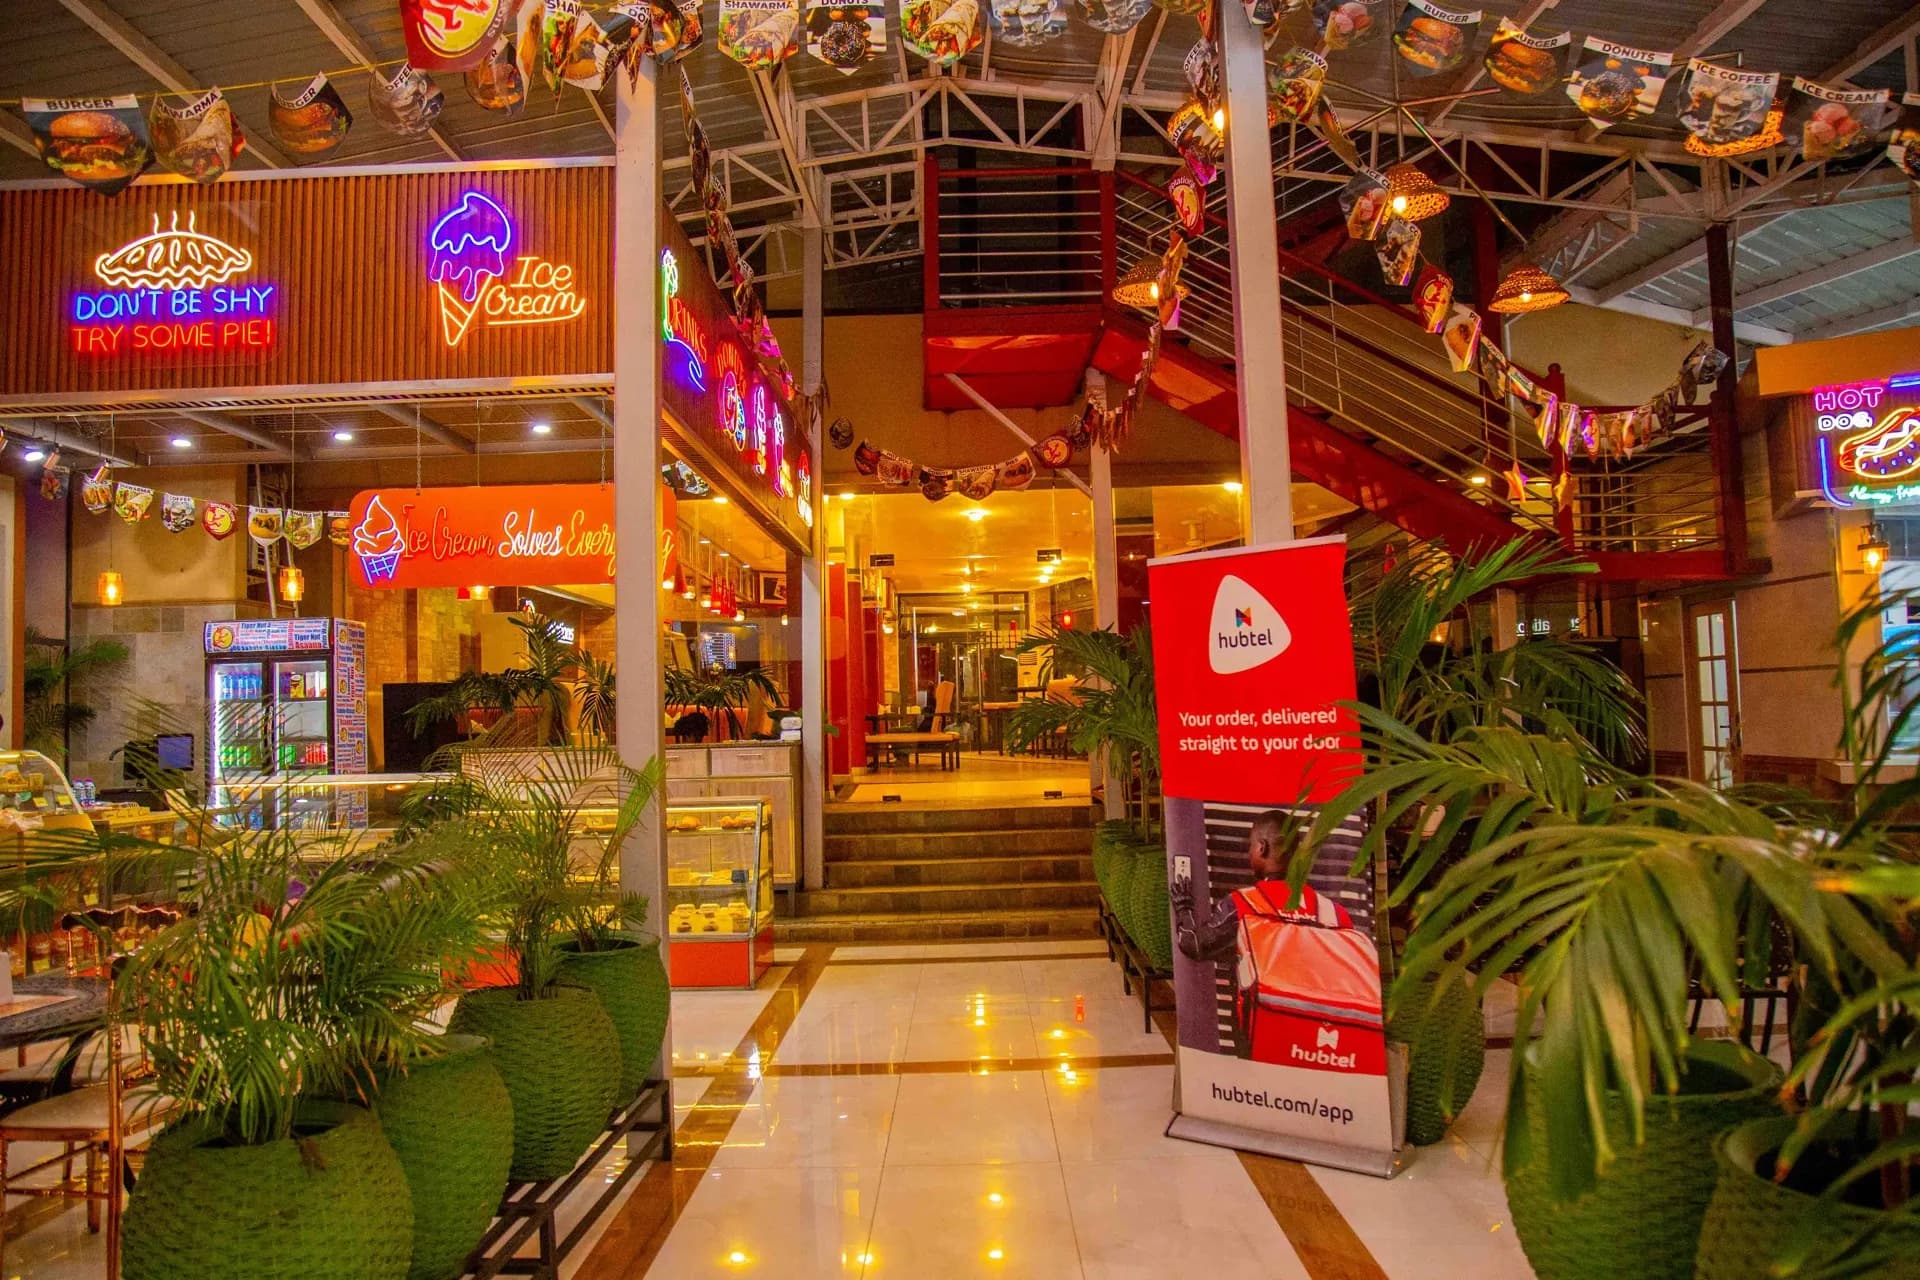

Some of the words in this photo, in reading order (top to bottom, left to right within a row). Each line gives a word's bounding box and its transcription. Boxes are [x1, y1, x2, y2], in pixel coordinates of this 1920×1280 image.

[1423, 4, 1469, 24] BURGER
[1514, 33, 1558, 48] URGER
[1602, 43, 1655, 62] DONUTS
[1696, 62, 1716, 76] ICE
[1719, 70, 1772, 85] COFFEE
[46, 98, 116, 110] BURGER
[1802, 83, 1822, 97] ICE
[1825, 90, 1878, 103] CREAM
[510, 256, 573, 291] Ice
[76, 288, 163, 320] DON'T
[171, 288, 202, 316] BE
[212, 286, 274, 313] SHY
[485, 285, 586, 319] Cream
[72, 324, 124, 351] TRY
[133, 322, 214, 348] SOME
[223, 320, 271, 345] PIE!
[1815, 386, 1883, 411] HOT
[402, 504, 431, 557] Ice
[431, 505, 495, 560] Cream
[498, 508, 564, 557] Solves
[1218, 628, 1273, 648] hubtel
[1179, 711, 1213, 727] Your
[1215, 709, 1258, 727] order,
[1262, 707, 1338, 726] delivered
[1179, 735, 1237, 755] straight
[1241, 735, 1258, 751] to
[1263, 736, 1298, 755] your
[1291, 1042, 1356, 1069] hubtel
[1211, 1082, 1354, 1127] hubtel.com/app
